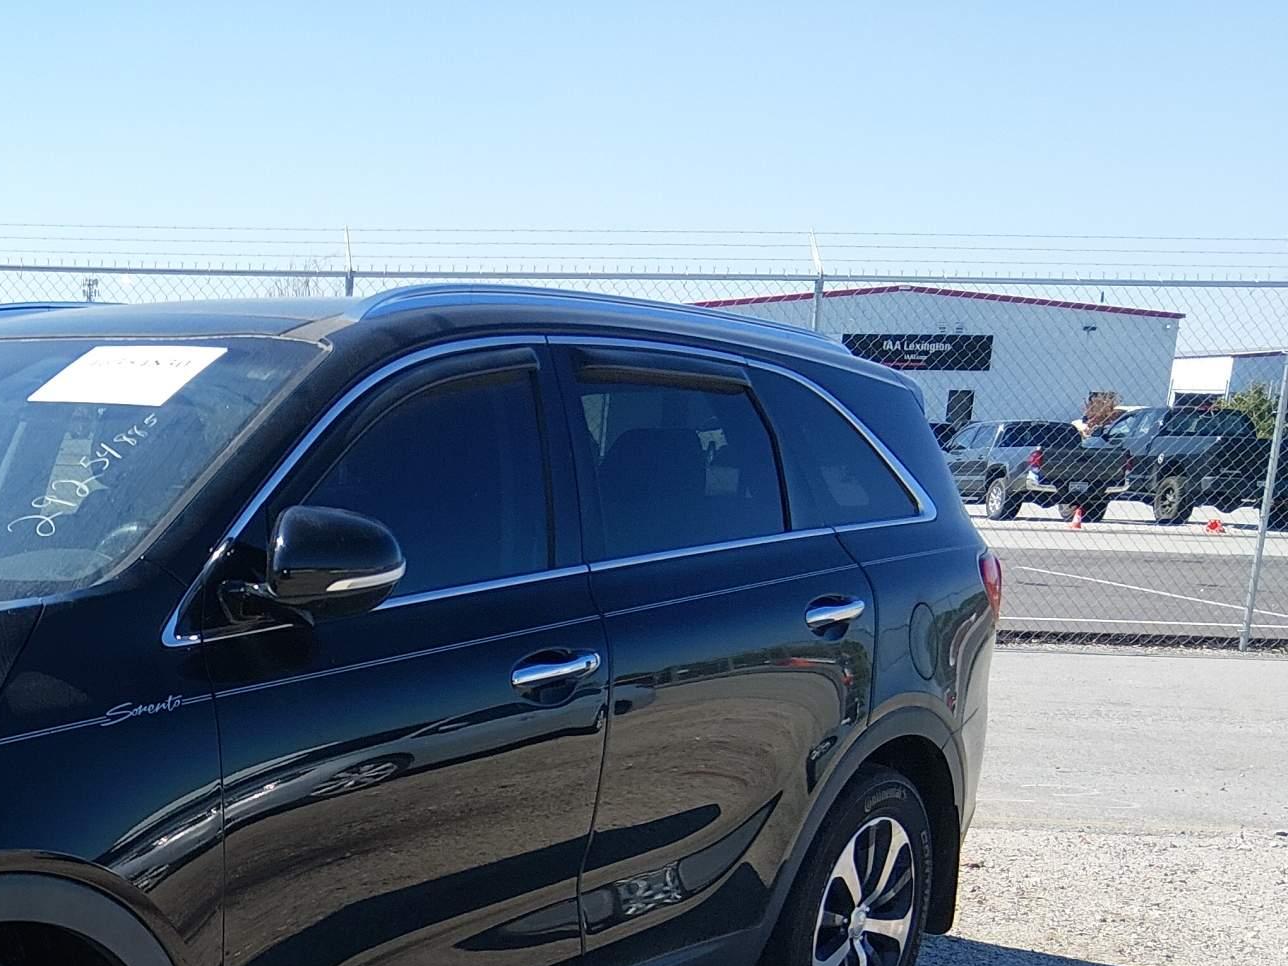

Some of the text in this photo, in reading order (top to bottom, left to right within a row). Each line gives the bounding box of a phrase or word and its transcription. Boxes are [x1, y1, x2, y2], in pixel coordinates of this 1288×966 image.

[882, 339, 951, 353] IAA Lexington
[100, 694, 183, 727] Sorento
